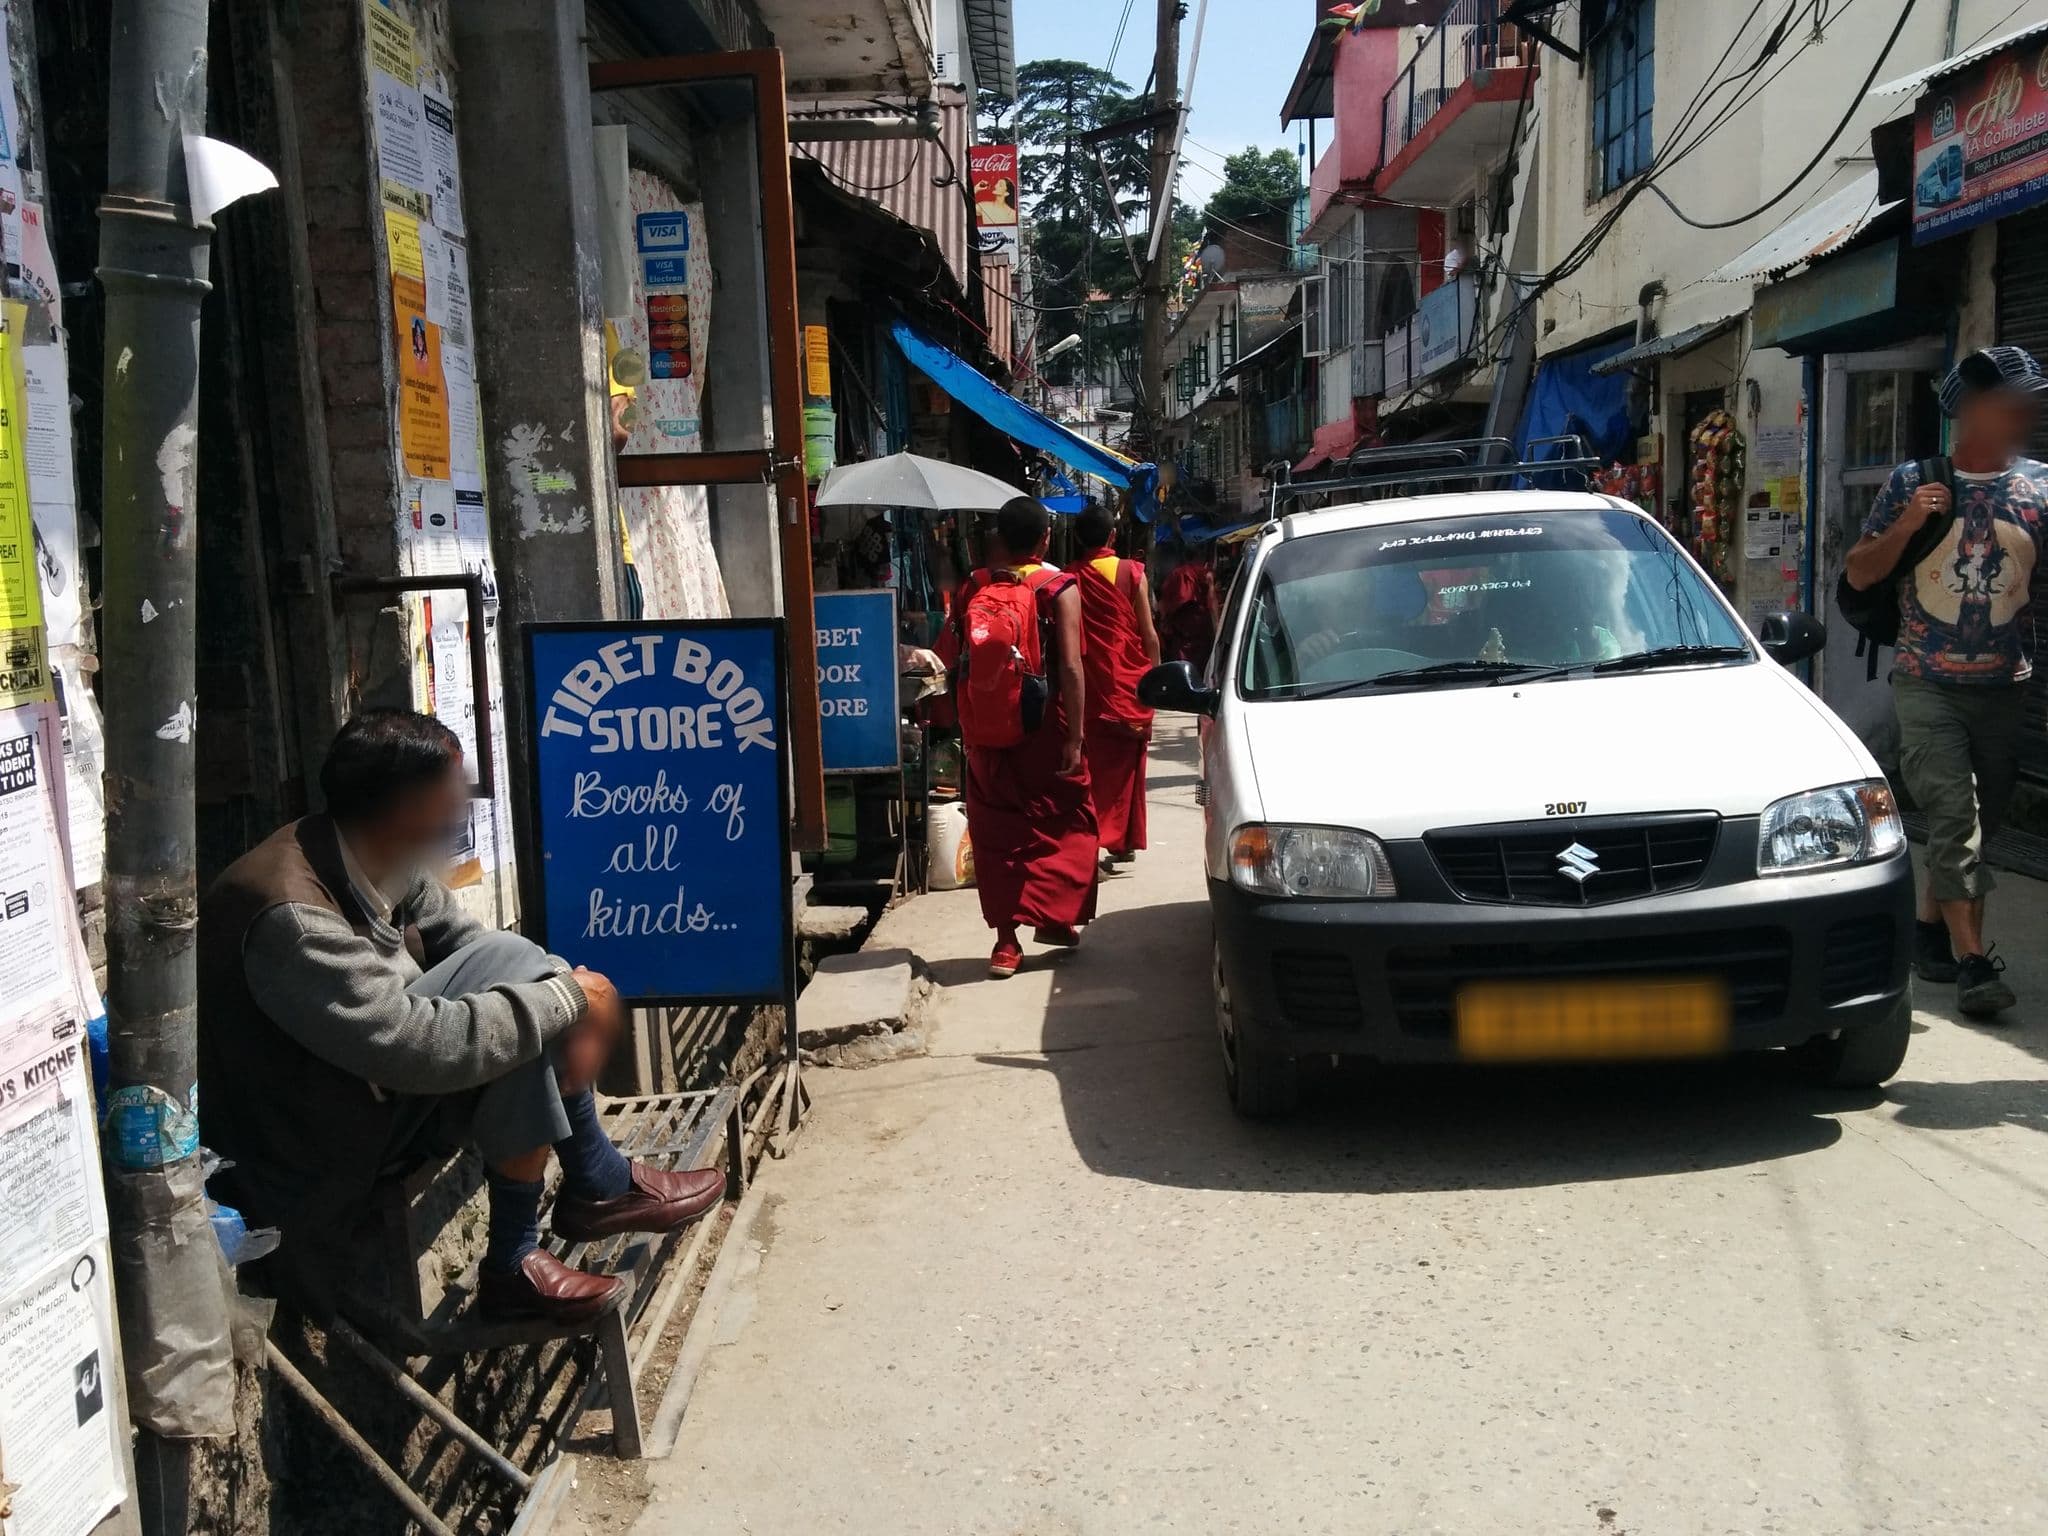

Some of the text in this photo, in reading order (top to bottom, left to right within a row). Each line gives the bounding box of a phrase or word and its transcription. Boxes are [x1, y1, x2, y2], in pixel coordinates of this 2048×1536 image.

[1983, 110, 2047, 148] Complete
[649, 226, 678, 238] VISA
[655, 260, 675, 270] VISA
[648, 274, 684, 284] Electron
[36, 276, 56, 304] Day
[649, 302, 689, 314] MasterCard
[655, 359, 688, 369] Maestro
[541, 635, 777, 753] TIBET BOOK
[588, 703, 723, 753] STORE
[16, 738, 30, 753] OF
[565, 769, 746, 841] Books of
[1544, 801, 1587, 816] 2007
[601, 824, 681, 873] all
[582, 885, 740, 939] kinds...
[22, 1295, 35, 1310] No
[35, 1290, 69, 1319] Therapy
